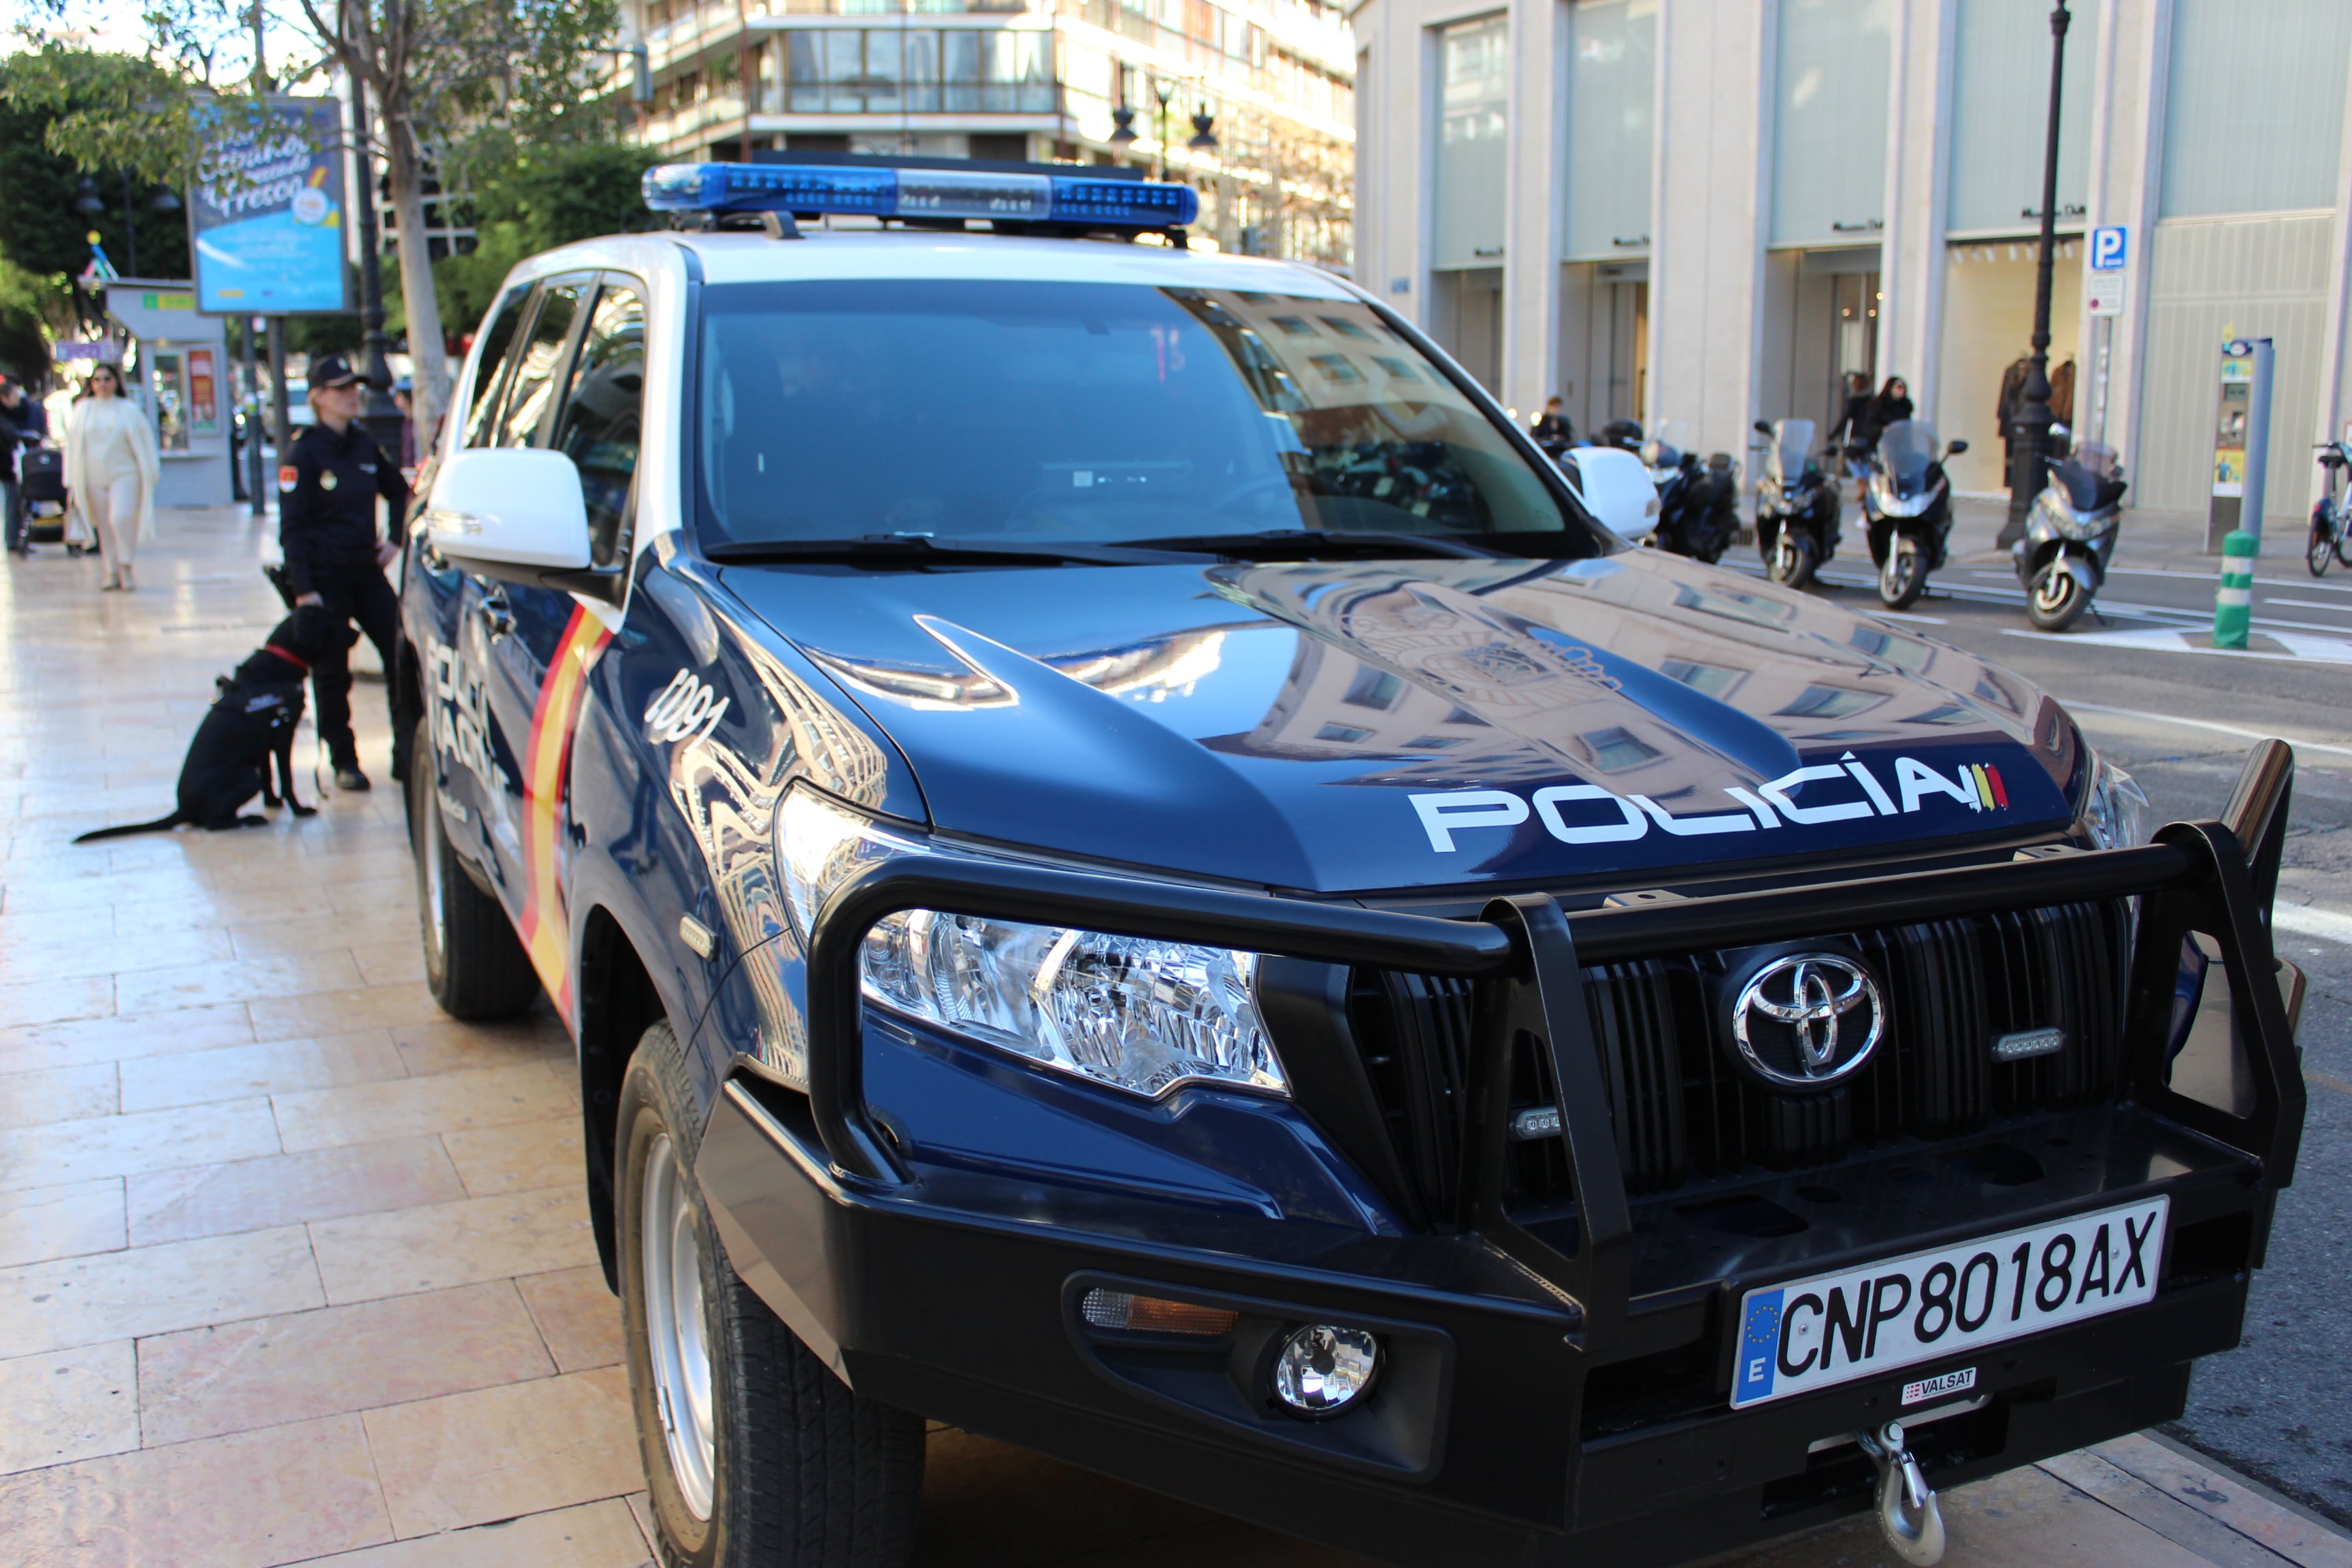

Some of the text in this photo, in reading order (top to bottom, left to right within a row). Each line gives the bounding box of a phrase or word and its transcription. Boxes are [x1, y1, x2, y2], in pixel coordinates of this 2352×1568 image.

[2095, 229, 2122, 268] P
[1407, 751, 1978, 853] POLICÍA
[1747, 1211, 2157, 1383] E CNP8018AX
[1921, 1369, 1973, 1394] VALSAT
